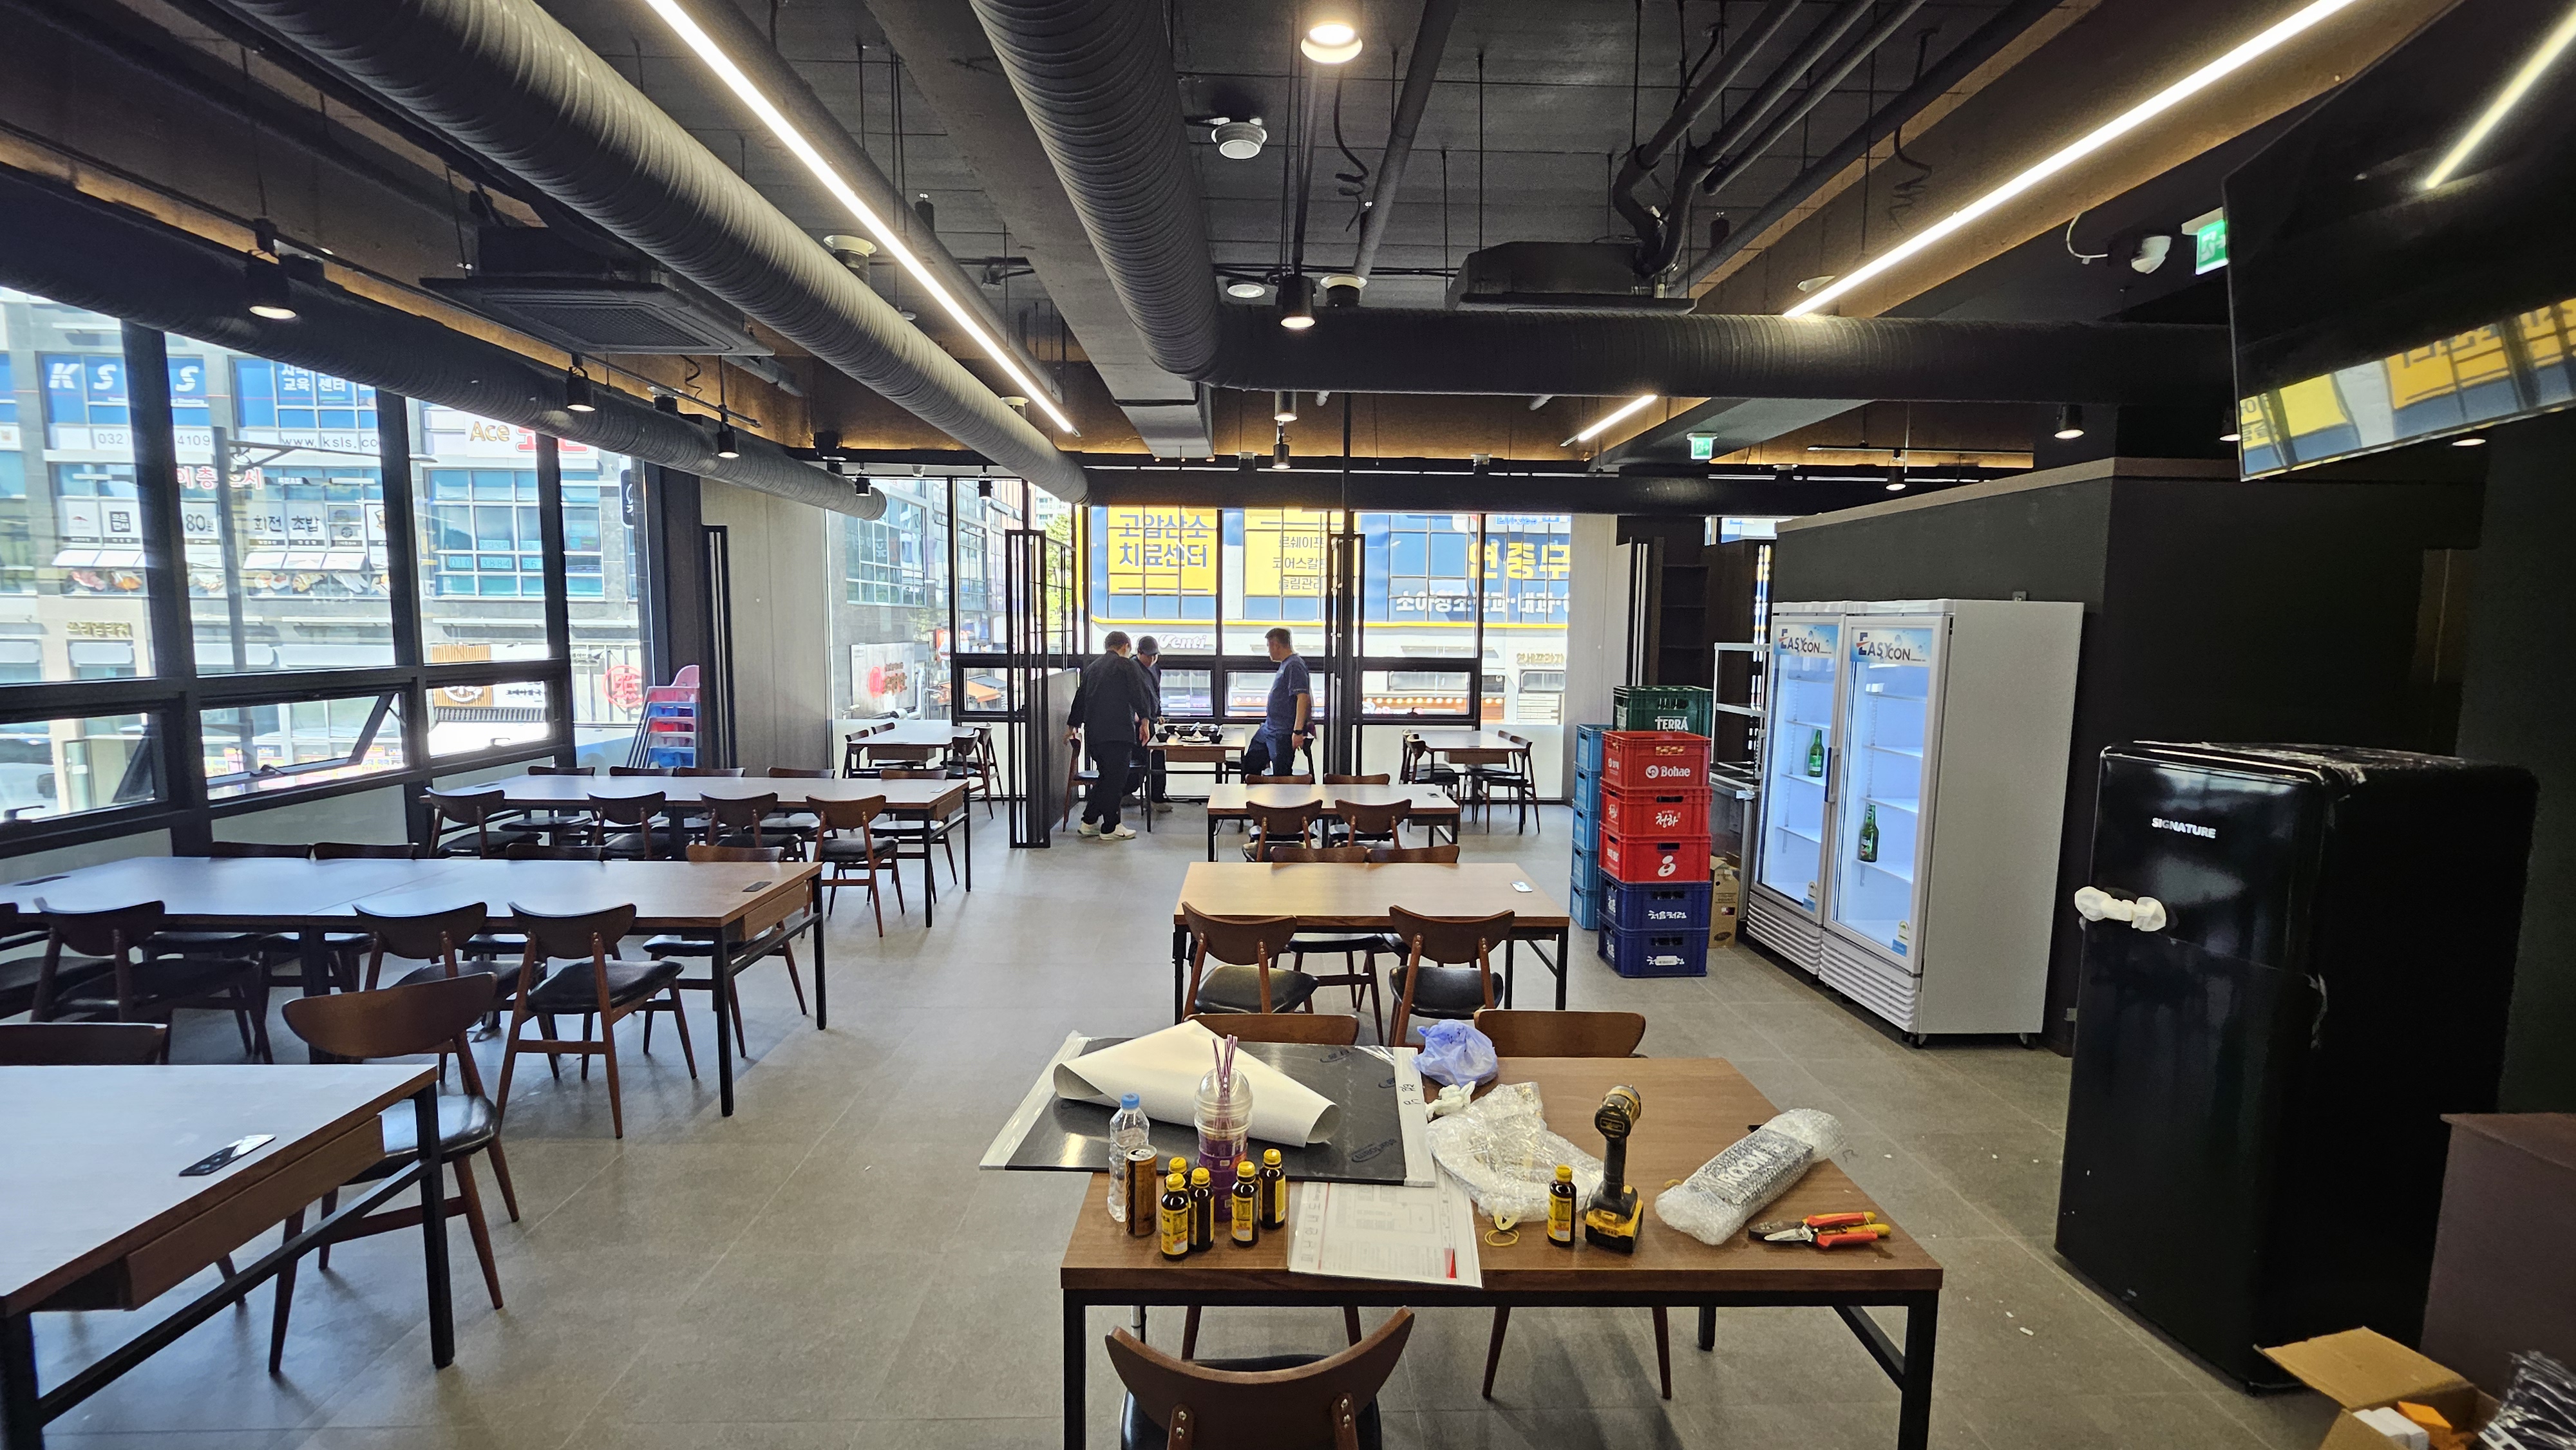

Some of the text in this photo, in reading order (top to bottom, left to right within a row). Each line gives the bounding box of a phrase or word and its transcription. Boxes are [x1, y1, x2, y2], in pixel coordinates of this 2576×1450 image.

[283, 377, 346, 391] 교육 센터
[469, 421, 509, 442] Ace
[1119, 514, 1208, 538] 고압산소
[1119, 542, 1207, 567] 치료센터
[1159, 634, 1207, 649] Venti
[1655, 716, 1689, 731] TERRA
[1660, 766, 1690, 777] Bohae
[1656, 812, 1679, 829] 청하
[2152, 817, 2216, 839] SIGNATURE
[1648, 910, 1687, 920] 처음처럼
